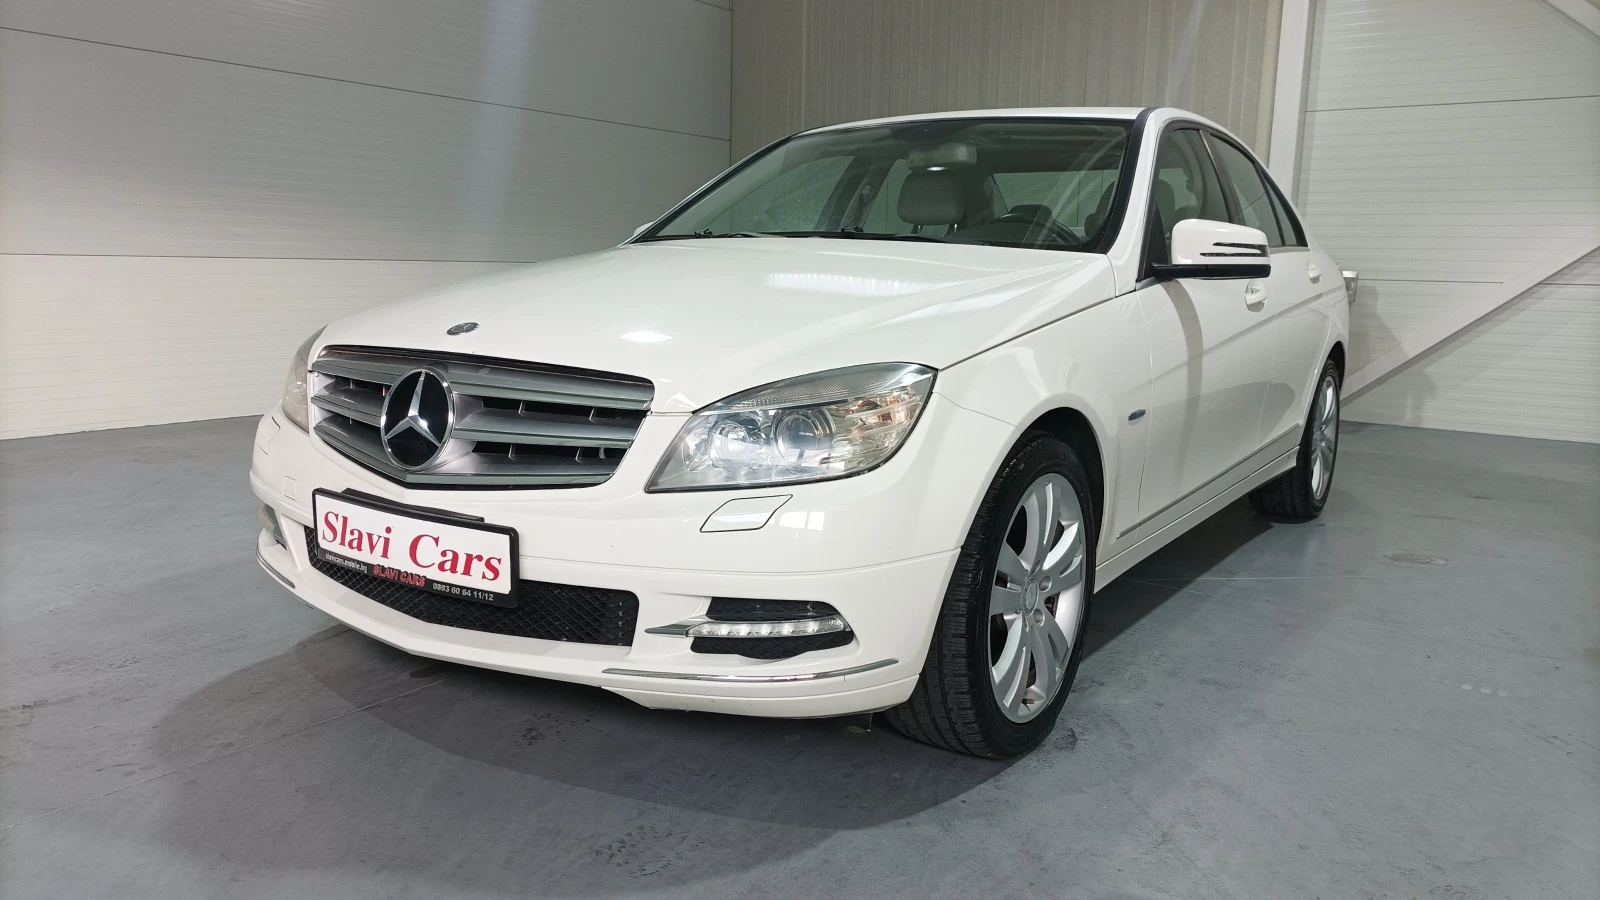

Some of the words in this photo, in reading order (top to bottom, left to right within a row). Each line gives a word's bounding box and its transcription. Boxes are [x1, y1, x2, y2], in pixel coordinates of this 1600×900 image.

[322, 511, 392, 559] Slavi
[409, 534, 502, 581] Cars
[325, 552, 368, 573] slavicars.mobile.bg
[373, 564, 399, 580] SLAVI
[400, 570, 426, 587] CARS
[451, 587, 461, 595] 60
[462, 589, 471, 597] 64
[473, 591, 494, 601] 11/12
